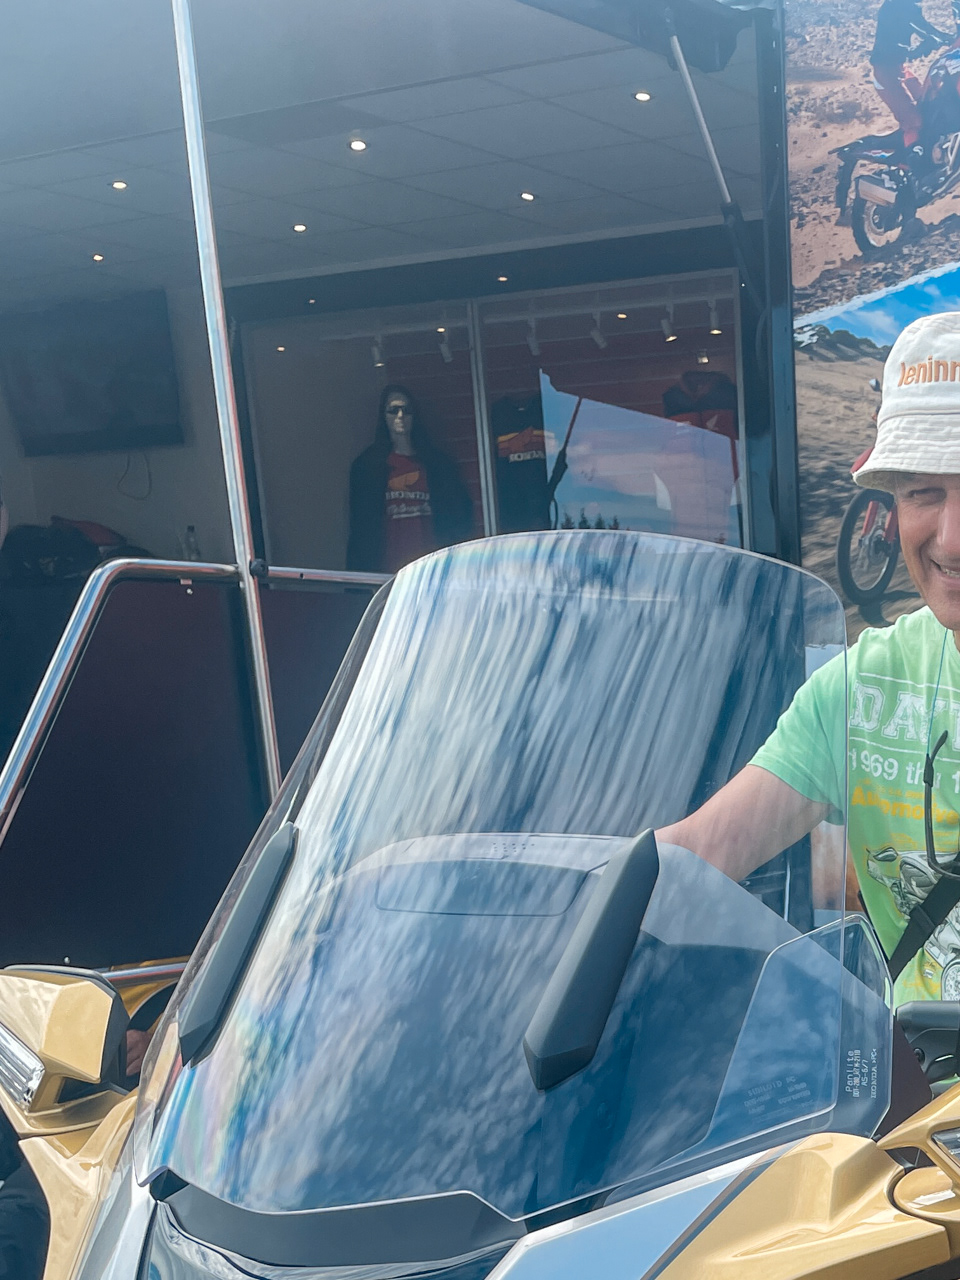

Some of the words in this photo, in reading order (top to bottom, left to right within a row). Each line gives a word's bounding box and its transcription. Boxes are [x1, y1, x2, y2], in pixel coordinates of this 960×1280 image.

[848, 747, 899, 778] 1969
[904, 762, 941, 789] th
[851, 785, 960, 826] Auomoive
[861, 1059, 869, 1087] AS-6/7
[870, 1065, 878, 1099] HONDA
